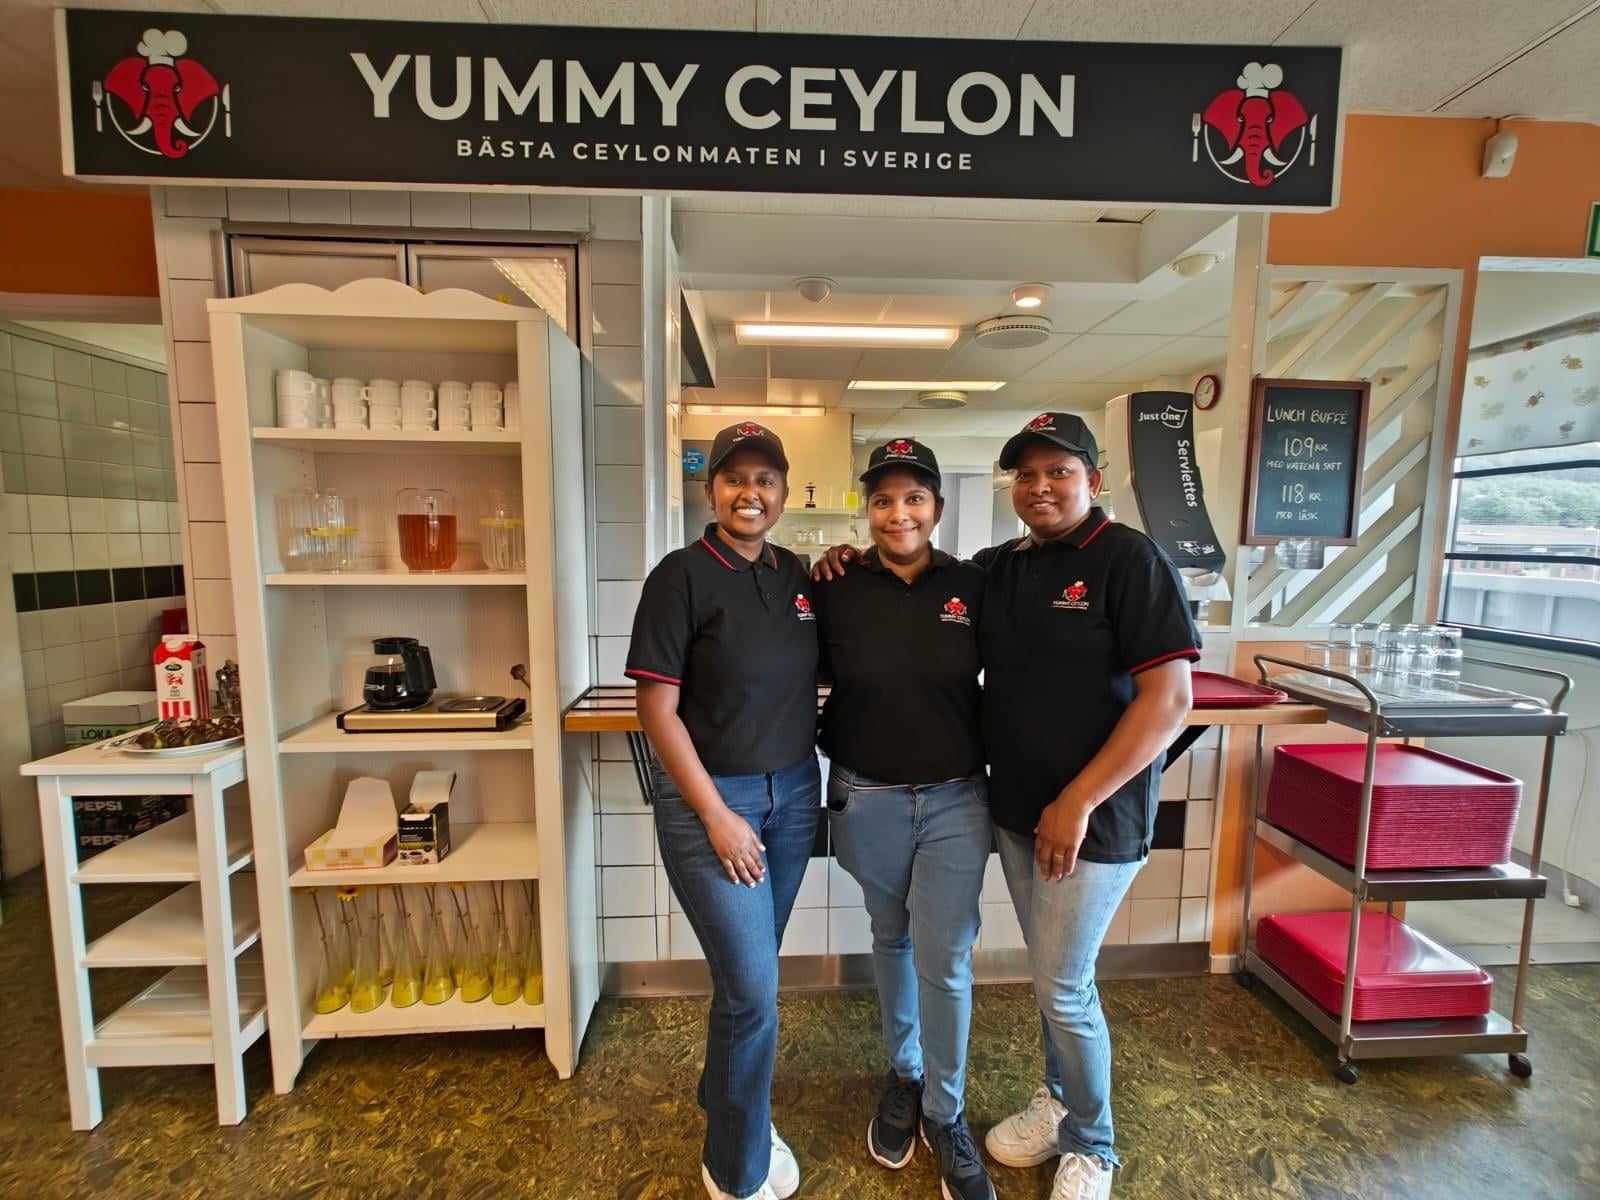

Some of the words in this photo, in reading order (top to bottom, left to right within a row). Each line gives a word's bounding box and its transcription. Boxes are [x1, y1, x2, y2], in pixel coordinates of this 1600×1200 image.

[350, 53, 700, 127] YUMMY
[724, 64, 1076, 138] CEYLON
[456, 136, 556, 160] BÄSTA
[573, 142, 801, 167] CEYLONMATEN
[819, 150, 826, 166] I
[843, 150, 973, 170] SVERIGE
[1267, 404, 1305, 423] LUNCH
[1284, 436, 1314, 458] 109
[1177, 439, 1198, 508] Serviettes
[1282, 483, 1304, 504] 118
[76, 800, 122, 811] PEPSI
